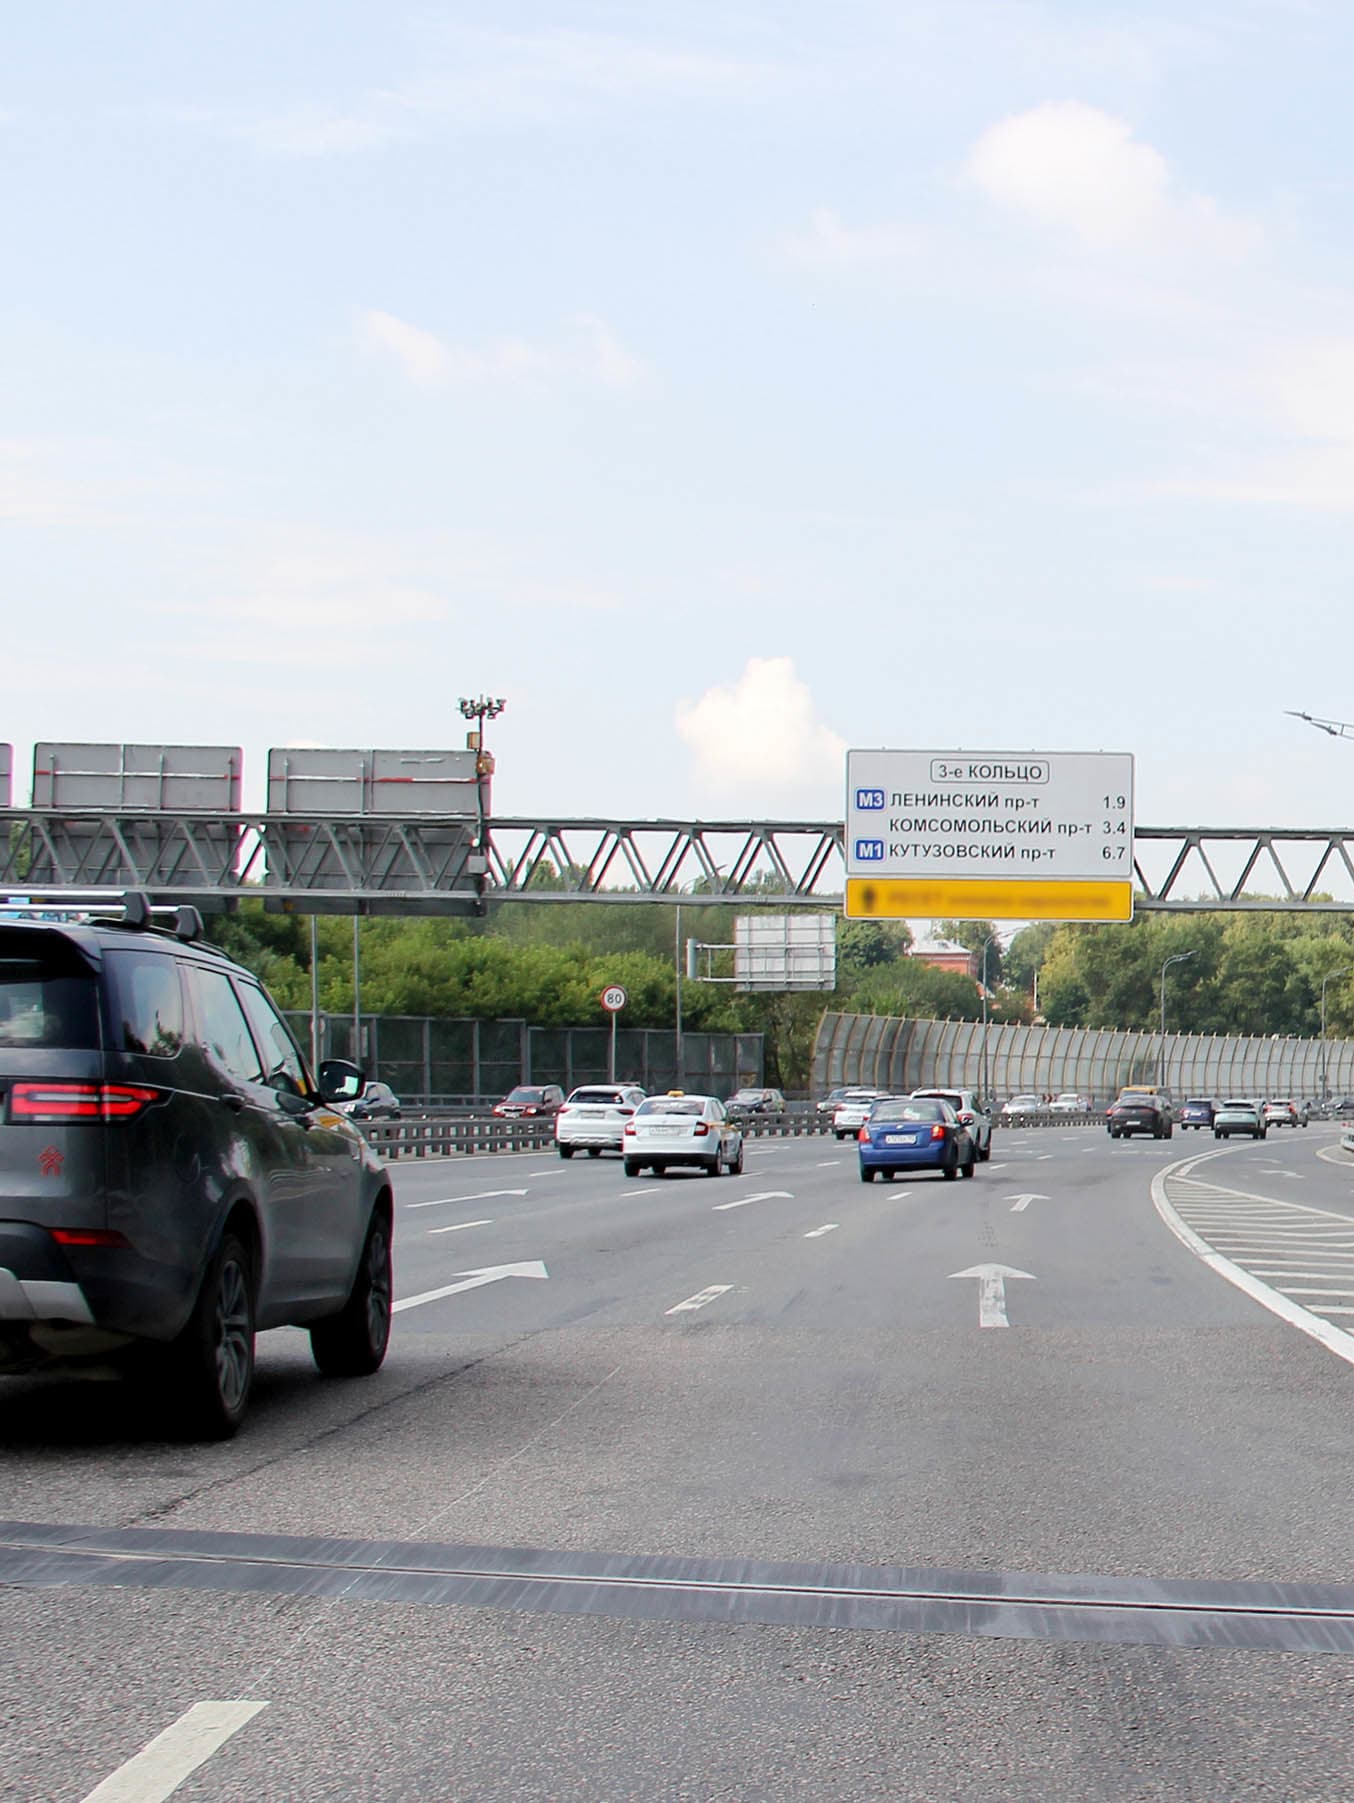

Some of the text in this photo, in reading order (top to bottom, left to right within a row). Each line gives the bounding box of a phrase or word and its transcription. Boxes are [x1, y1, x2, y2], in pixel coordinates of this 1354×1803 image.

[939, 764, 1042, 781] 3-е КОЛЬЦО
[859, 792, 1126, 811] М3 ЛЕНИНСКИЙ пр-т 1.9
[890, 817, 1126, 837] КОМСОМОЛЬСКИЙ пр-т 3.4
[859, 842, 1126, 862] М1 КУТУЗОВСКИЙ пр-т 6.7
[607, 993, 622, 1004] 80
